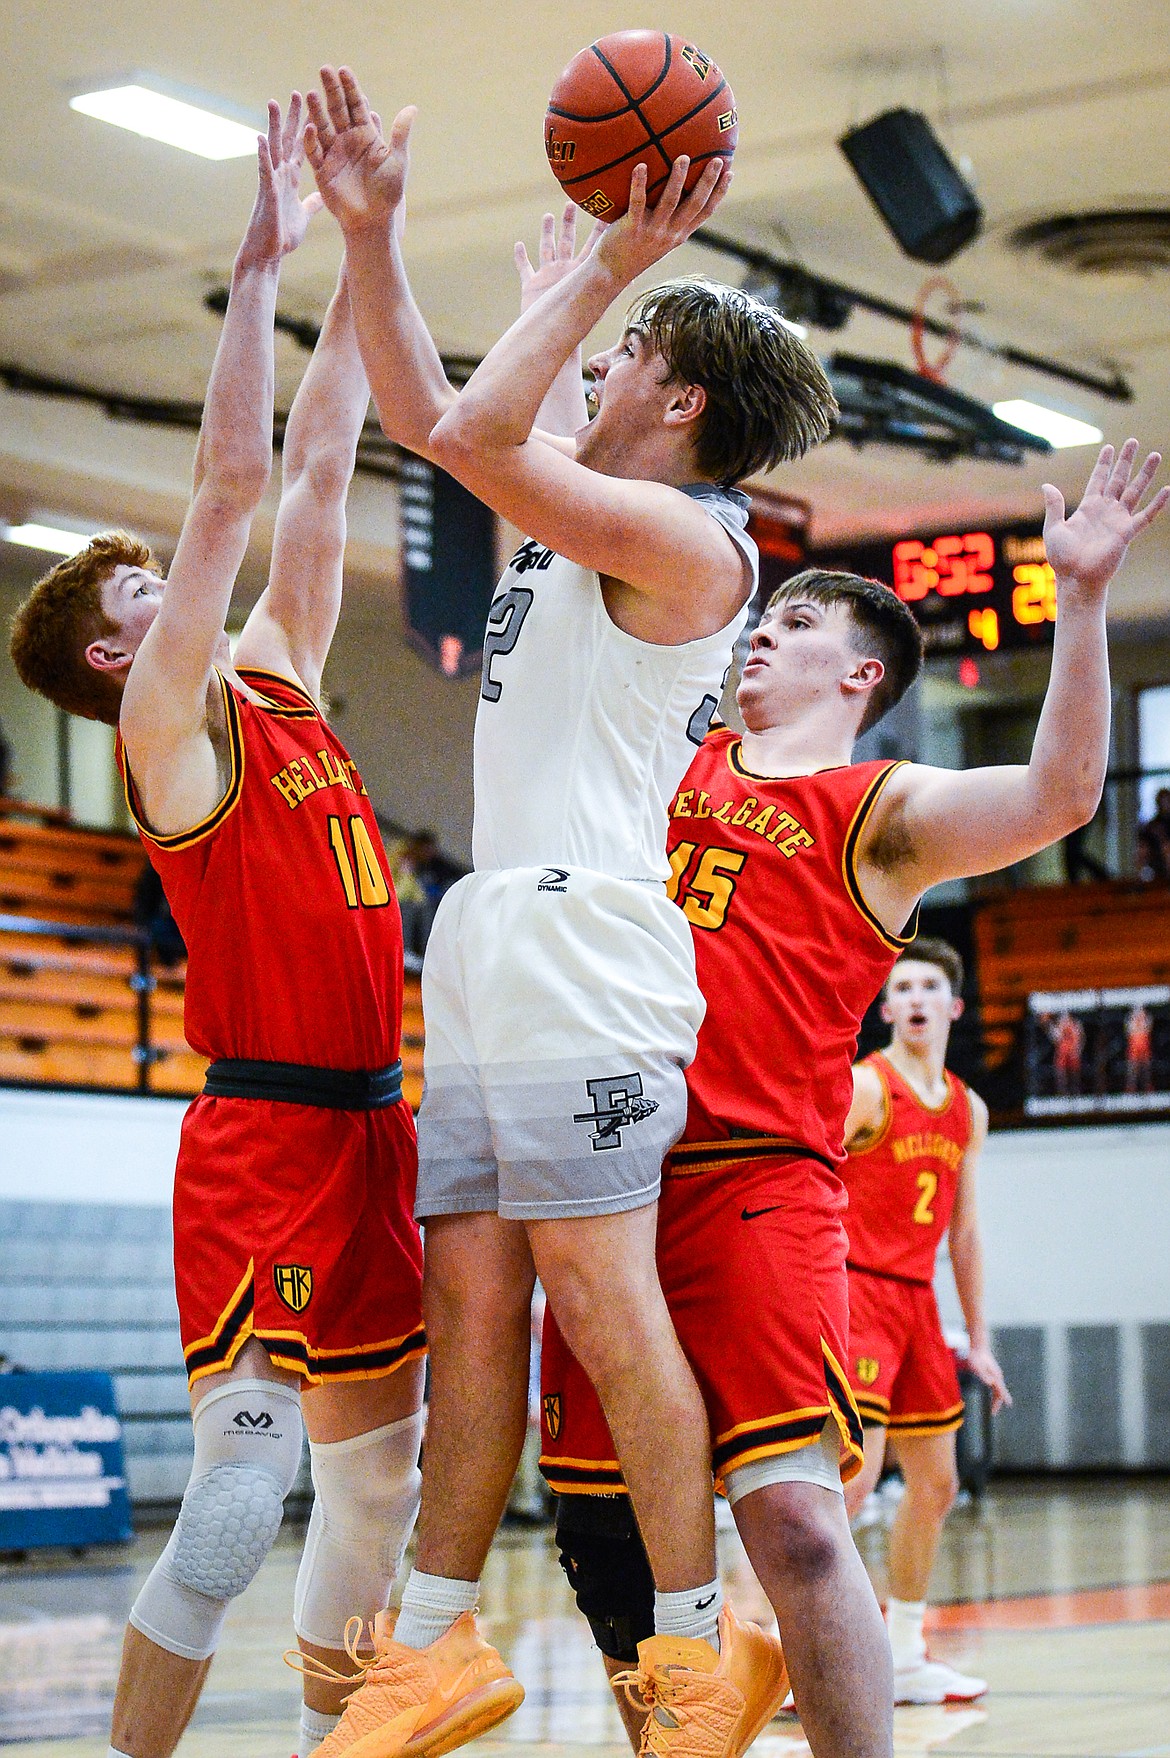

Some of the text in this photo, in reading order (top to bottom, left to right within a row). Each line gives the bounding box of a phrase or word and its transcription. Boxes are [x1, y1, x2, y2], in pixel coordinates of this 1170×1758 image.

[893, 532, 995, 600] 6:52
[668, 789, 816, 859] ELLGATE
[327, 814, 390, 909] 10
[537, 885, 567, 893] DYNAMIC
[913, 1171, 938, 1224] 2
[278, 1268, 311, 1309] HK
